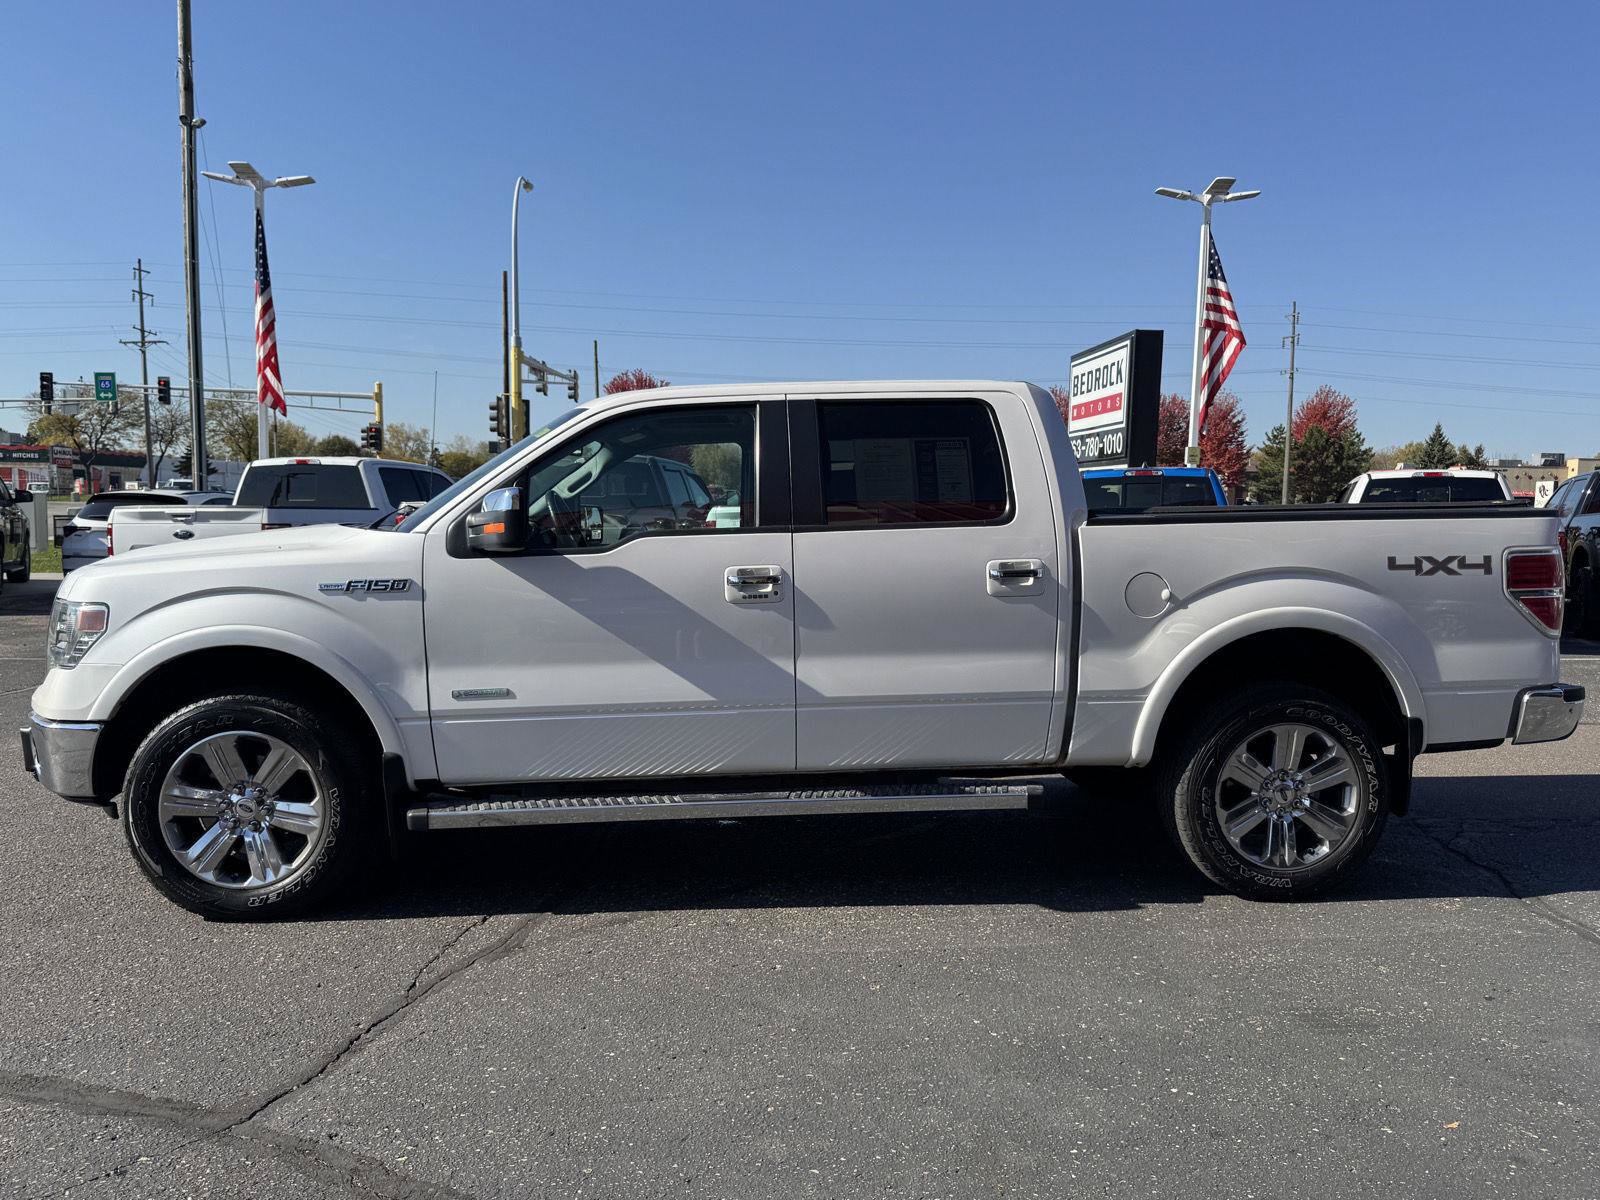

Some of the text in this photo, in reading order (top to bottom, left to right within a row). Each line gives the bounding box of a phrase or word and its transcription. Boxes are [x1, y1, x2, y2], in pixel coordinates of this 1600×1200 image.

[100, 381, 111, 389] 65
[1073, 358, 1124, 397] BEDROCK
[1073, 397, 1120, 417] MOTORS
[1387, 555, 1493, 577] 4X4
[1286, 707, 1380, 813] GOODYEAR
[247, 787, 342, 908] WRANGLER
[1201, 786, 1293, 888] WRANGLER
